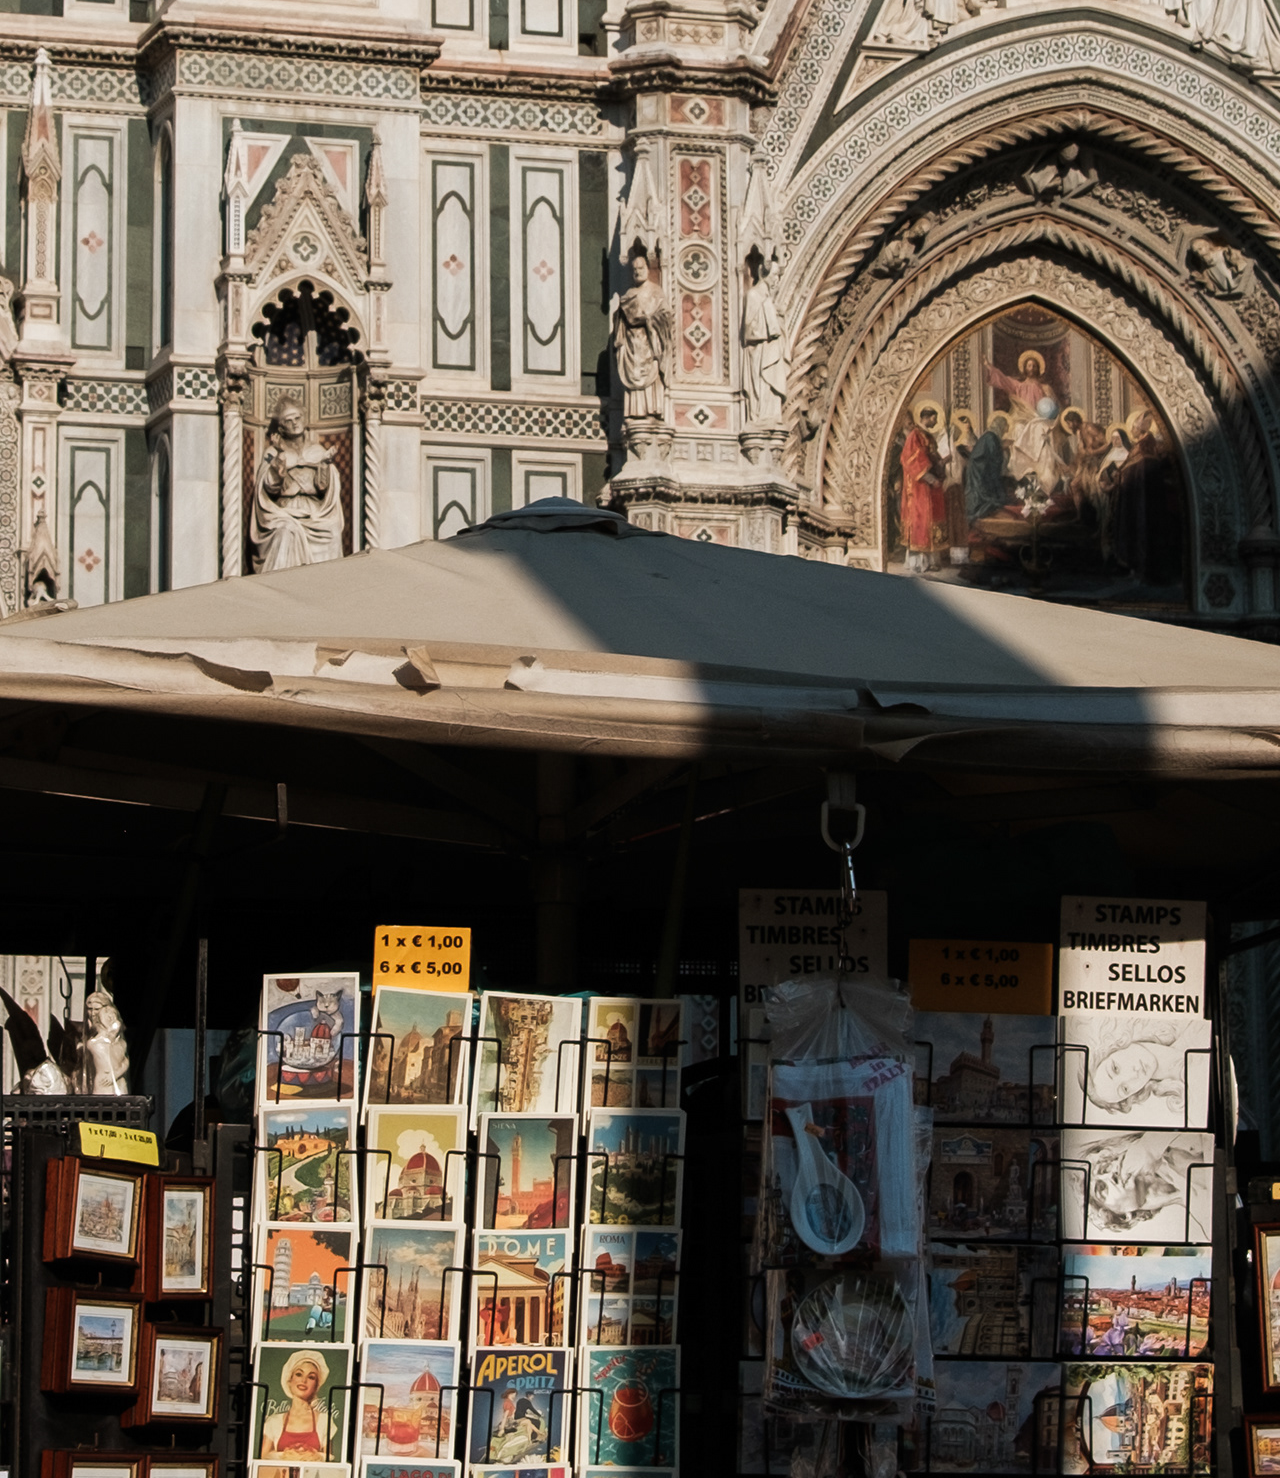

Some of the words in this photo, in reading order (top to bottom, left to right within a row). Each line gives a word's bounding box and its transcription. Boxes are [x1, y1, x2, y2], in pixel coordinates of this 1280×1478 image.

[1095, 903, 1182, 926] STAMPS
[381, 934, 390, 947] 1
[397, 937, 407, 947] x
[412, 935, 423, 948] €
[427, 935, 464, 950] 1,00
[746, 925, 842, 945] TIMBRES
[1067, 932, 1161, 954] TIMBRES
[942, 947, 949, 959] 1
[956, 950, 966, 959] x
[969, 948, 980, 960] €
[985, 948, 1019, 963] 1,00
[379, 961, 390, 974] 6
[395, 964, 406, 974] x
[411, 962, 422, 974] €
[425, 962, 463, 977] 5,00
[1108, 963, 1187, 984] SELLOS
[941, 972, 951, 985] 6
[954, 975, 964, 985] x
[969, 973, 980, 985] €
[984, 973, 1019, 989] 5,00
[1063, 989, 1199, 1013] BRIEFMARKEN
[862, 1063, 907, 1093] ITALY
[599, 1234, 626, 1245] ROMA
[476, 1353, 559, 1388] APEROL
[506, 1376, 555, 1391] SPRITZ
